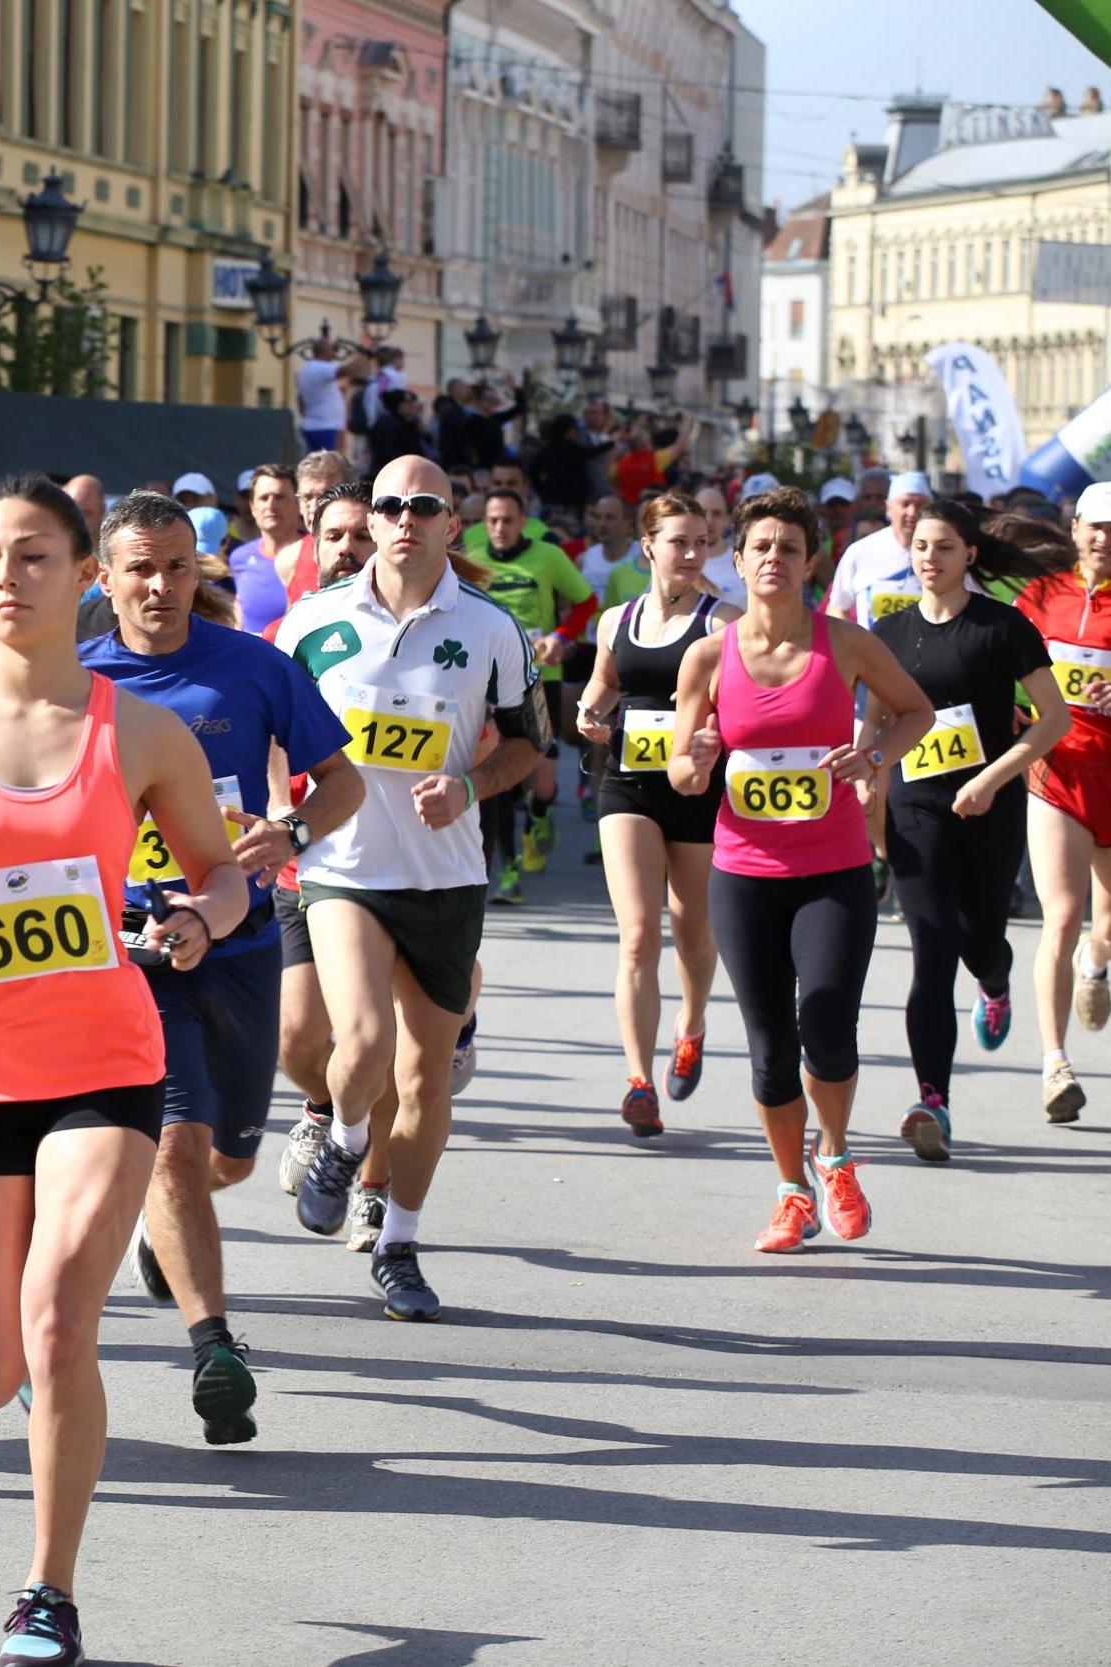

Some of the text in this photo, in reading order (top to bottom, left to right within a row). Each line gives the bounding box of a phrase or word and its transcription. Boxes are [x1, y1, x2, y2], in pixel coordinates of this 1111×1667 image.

[361, 721, 434, 761] 127
[913, 734, 967, 769] 214
[743, 775, 818, 812] 663
